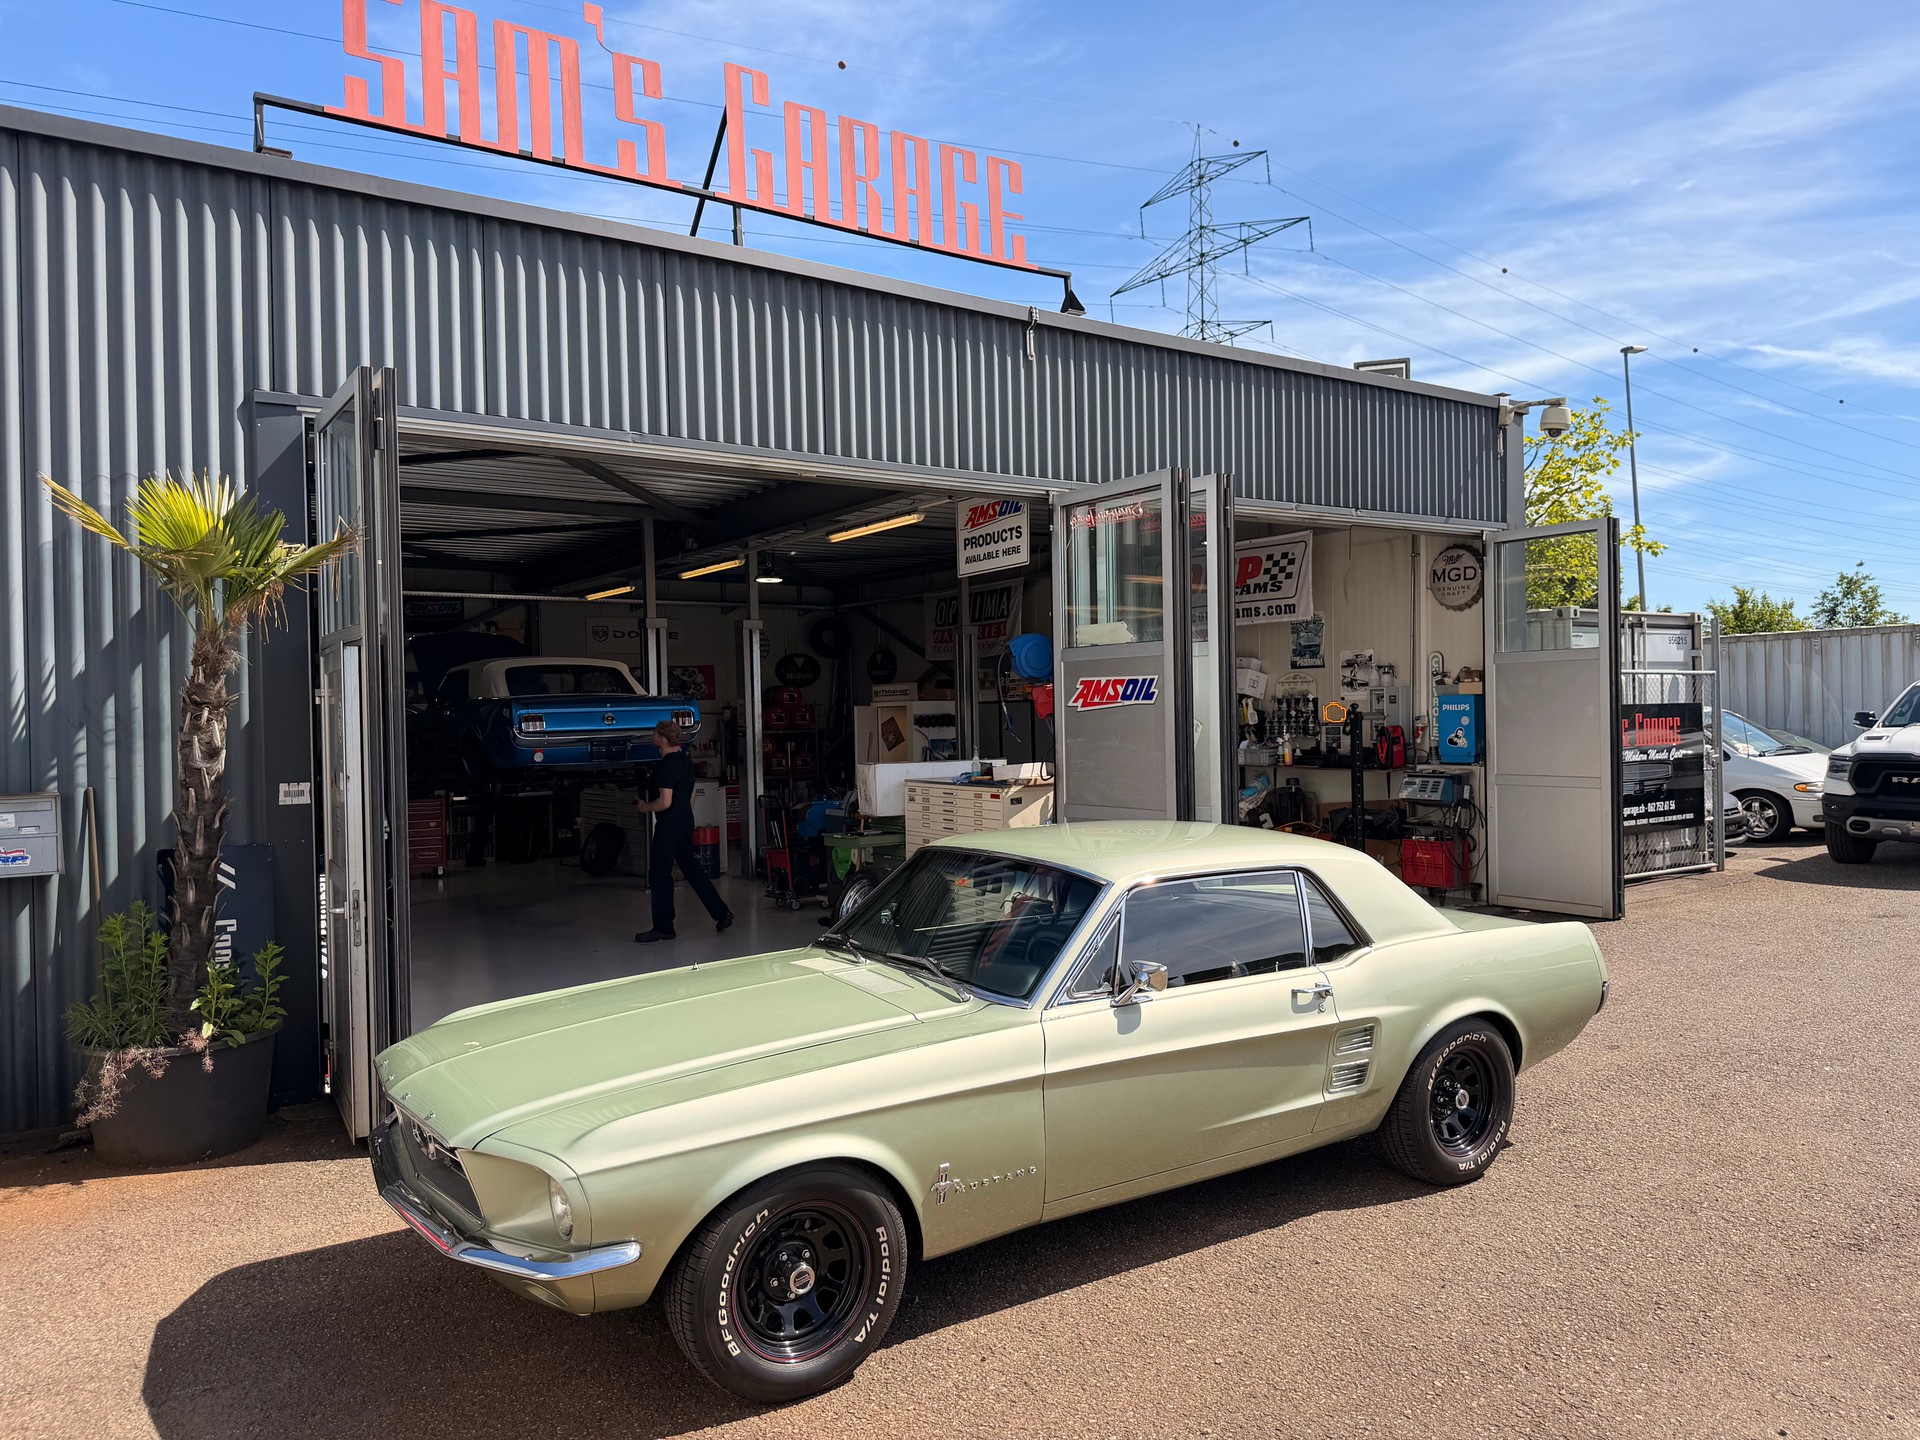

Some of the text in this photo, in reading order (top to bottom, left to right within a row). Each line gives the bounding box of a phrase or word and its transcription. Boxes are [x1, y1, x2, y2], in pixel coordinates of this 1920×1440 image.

[964, 500, 1023, 530] AMSOIL
[963, 525, 1023, 550] PRODUCTS
[964, 545, 1021, 565] AVAILABLE HERE
[1234, 555, 1263, 588] P
[1432, 566, 1477, 583] MGD
[936, 589, 1009, 625] OPIMA
[612, 630, 679, 640] DOE
[1073, 677, 1158, 707] AMSOIL
[1624, 750, 1647, 761] Modern
[1648, 749, 1668, 760] Muscle
[1458, 1119, 1507, 1172] Radial T/A
[953, 1166, 1037, 1193] MUSTANG
[854, 1226, 892, 1343] Radial T/A
